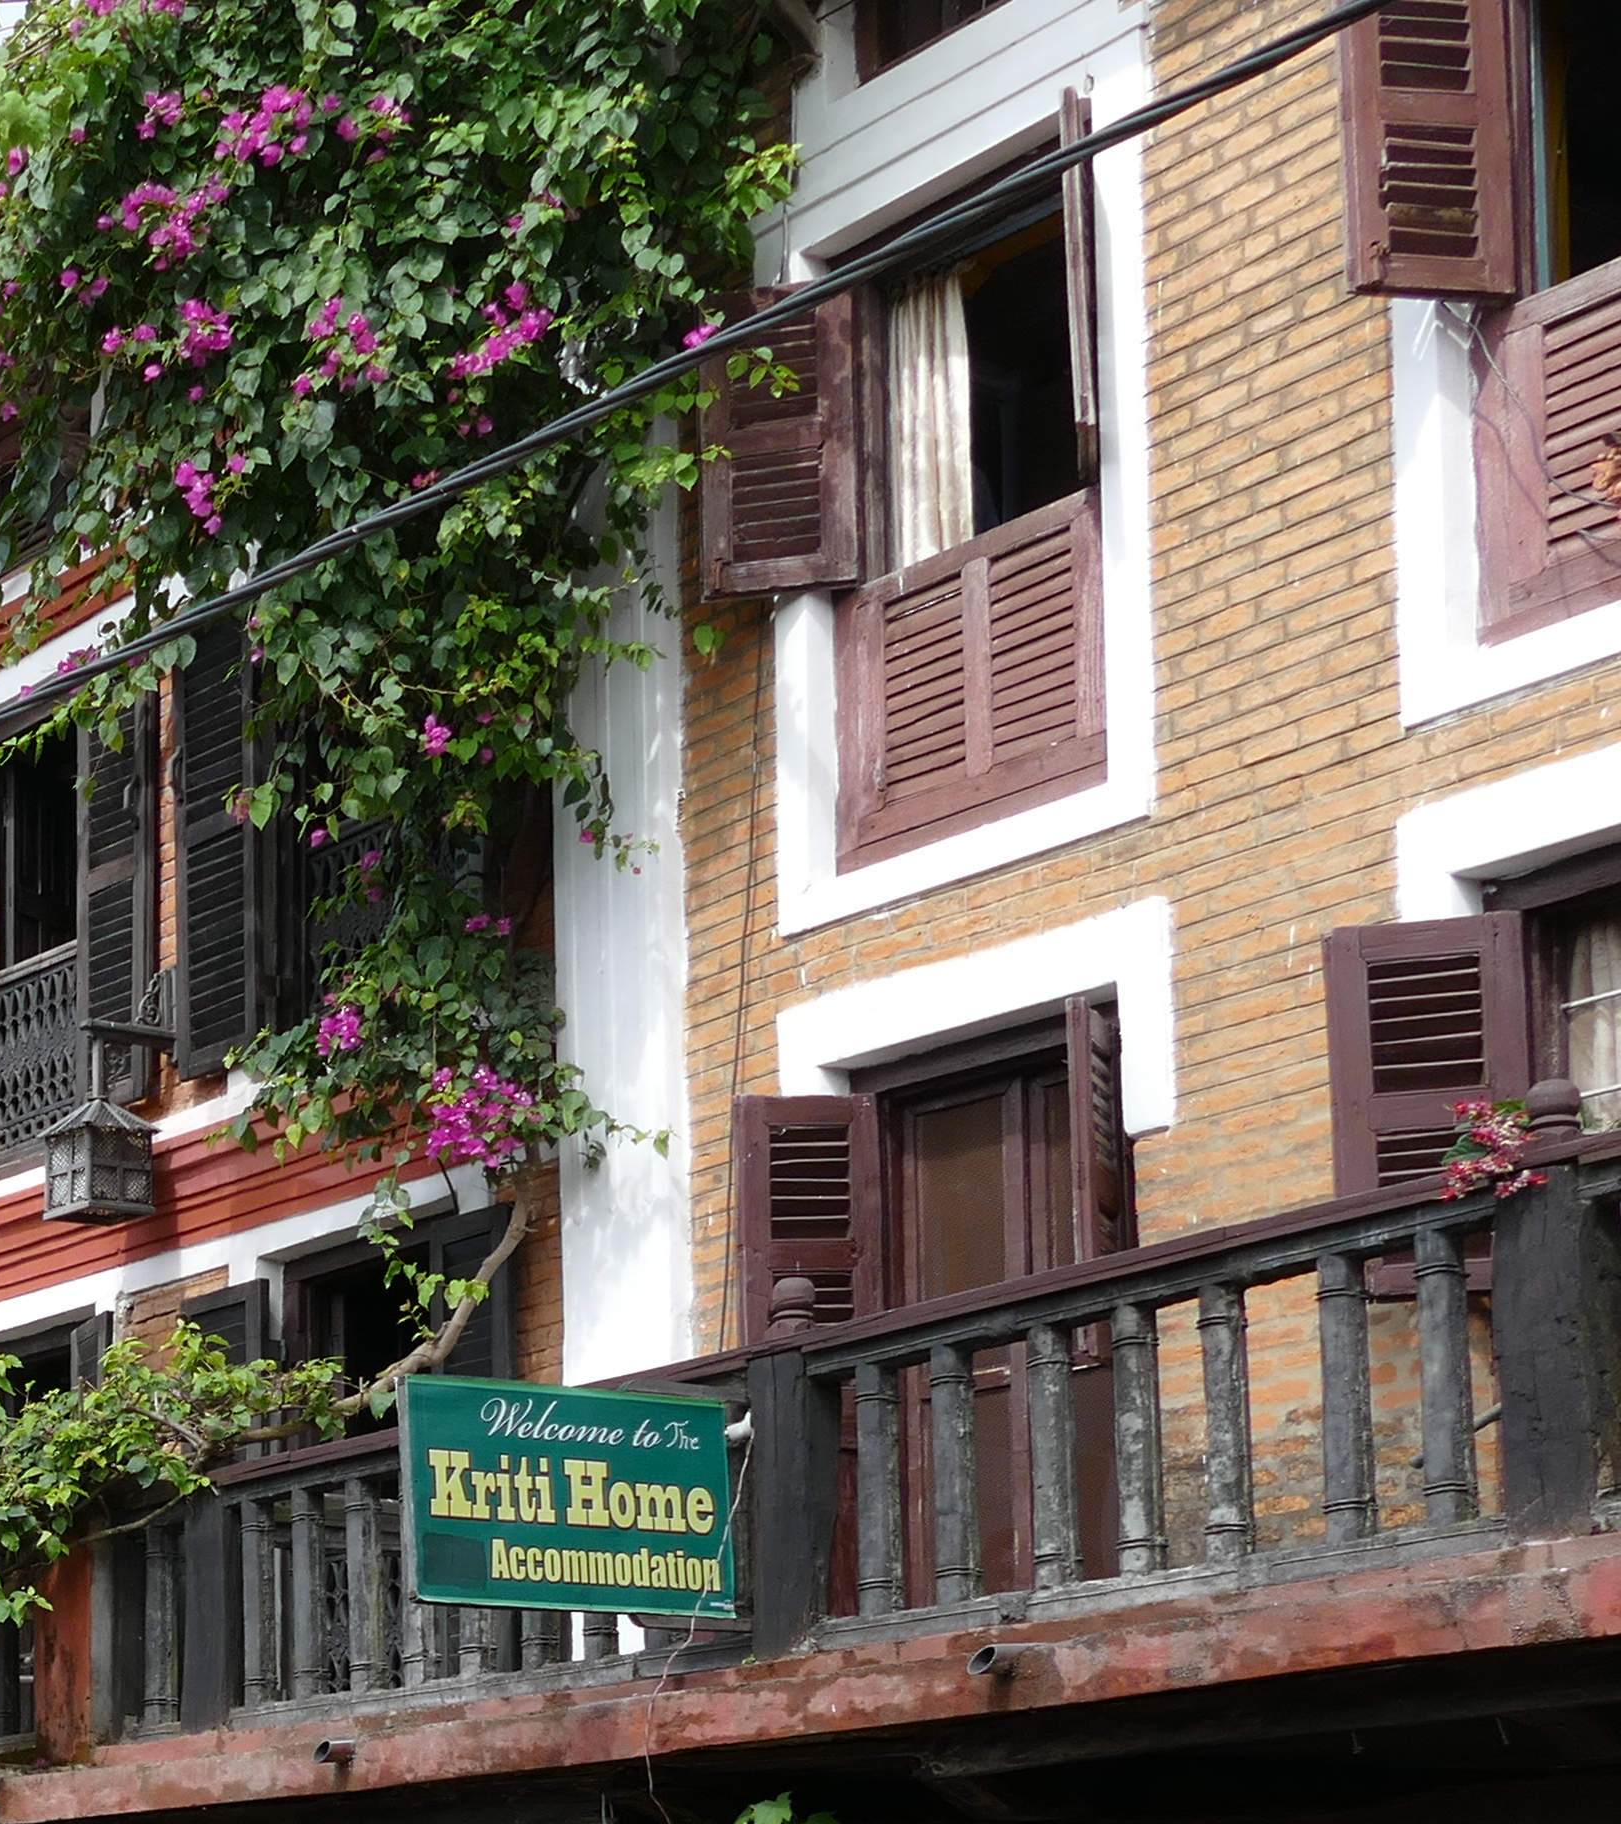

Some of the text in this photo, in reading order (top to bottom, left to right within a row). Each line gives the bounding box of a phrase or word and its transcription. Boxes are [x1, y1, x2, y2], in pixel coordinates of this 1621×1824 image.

[480, 1396, 701, 1451] Welcome to The
[427, 1447, 716, 1536] Kriti Home
[489, 1537, 722, 1593] Accommodation
